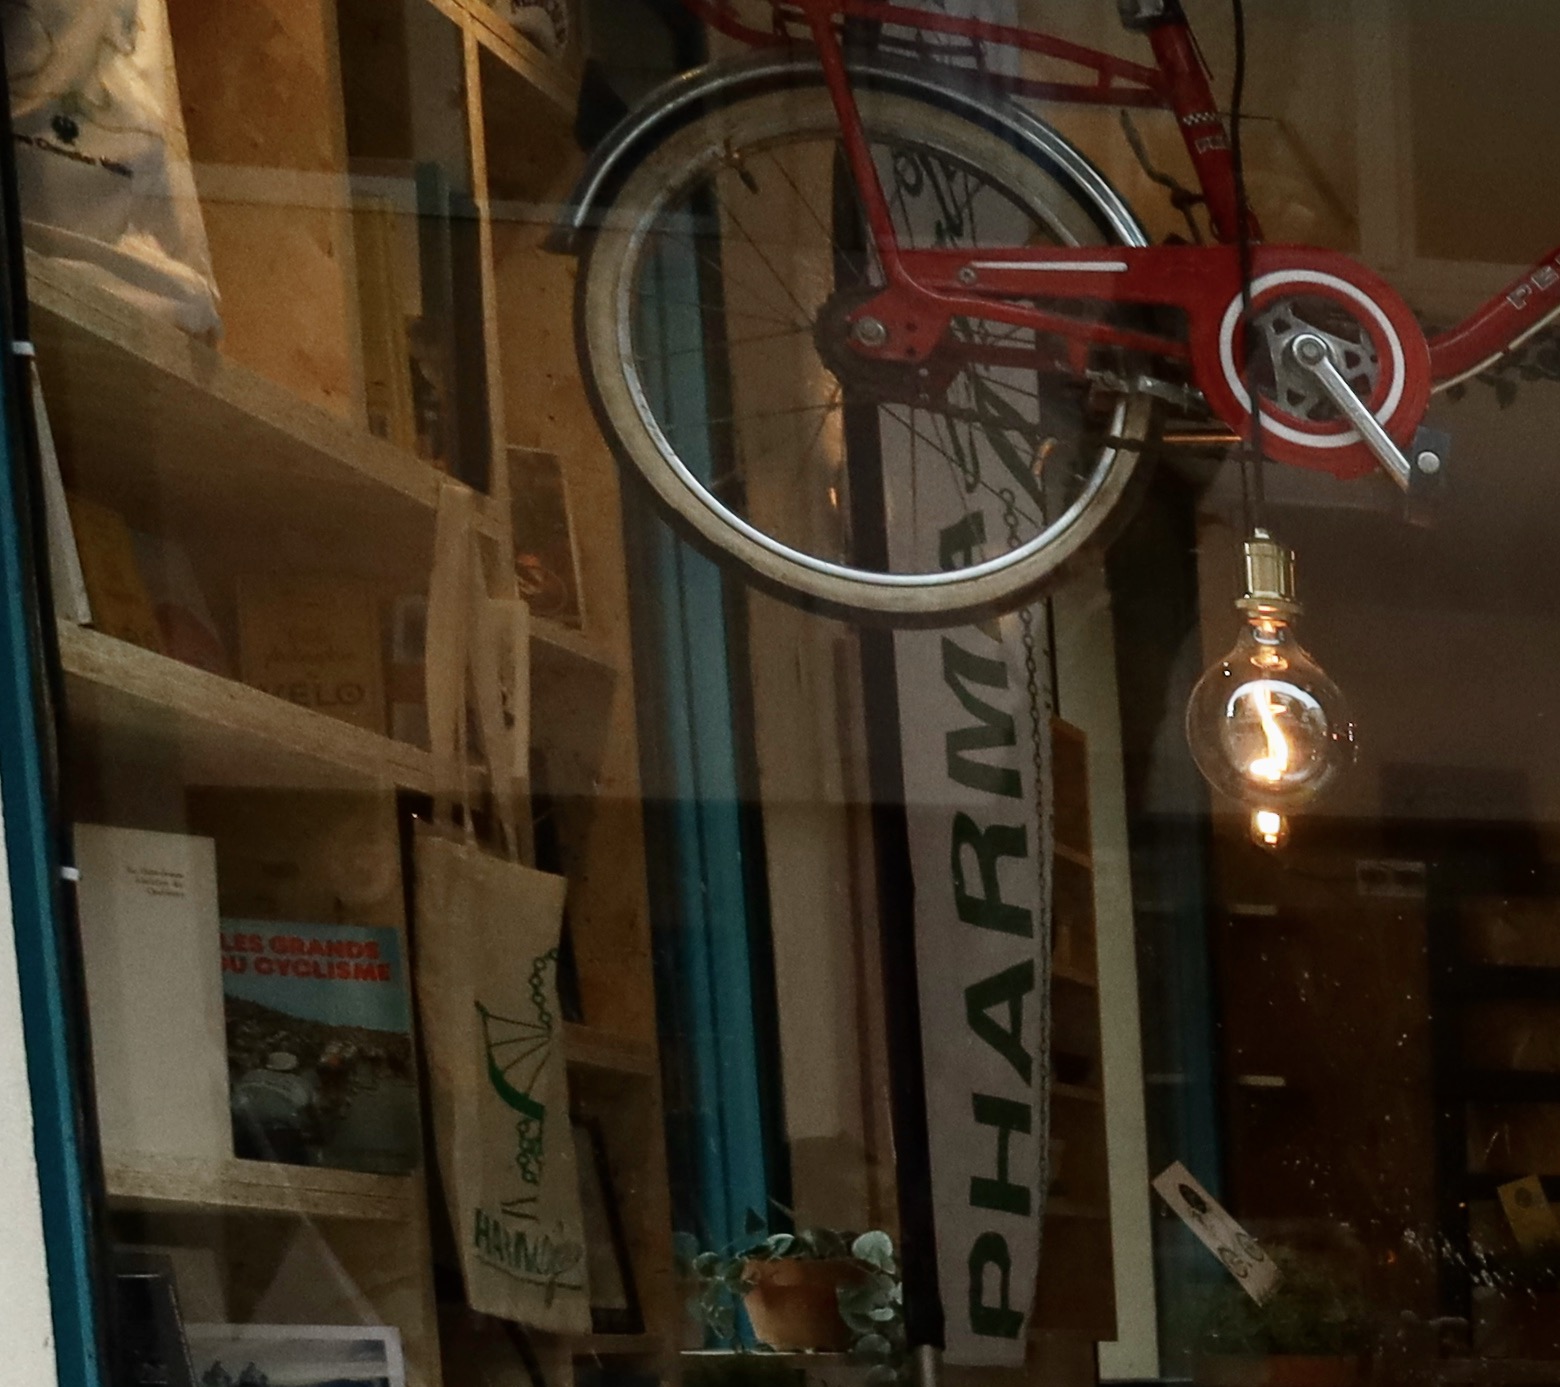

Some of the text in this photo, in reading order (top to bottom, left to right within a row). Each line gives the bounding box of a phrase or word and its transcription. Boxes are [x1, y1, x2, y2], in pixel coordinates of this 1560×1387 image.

[220, 933, 379, 959] LES GRANDS
[254, 956, 390, 981] CYCLISME
